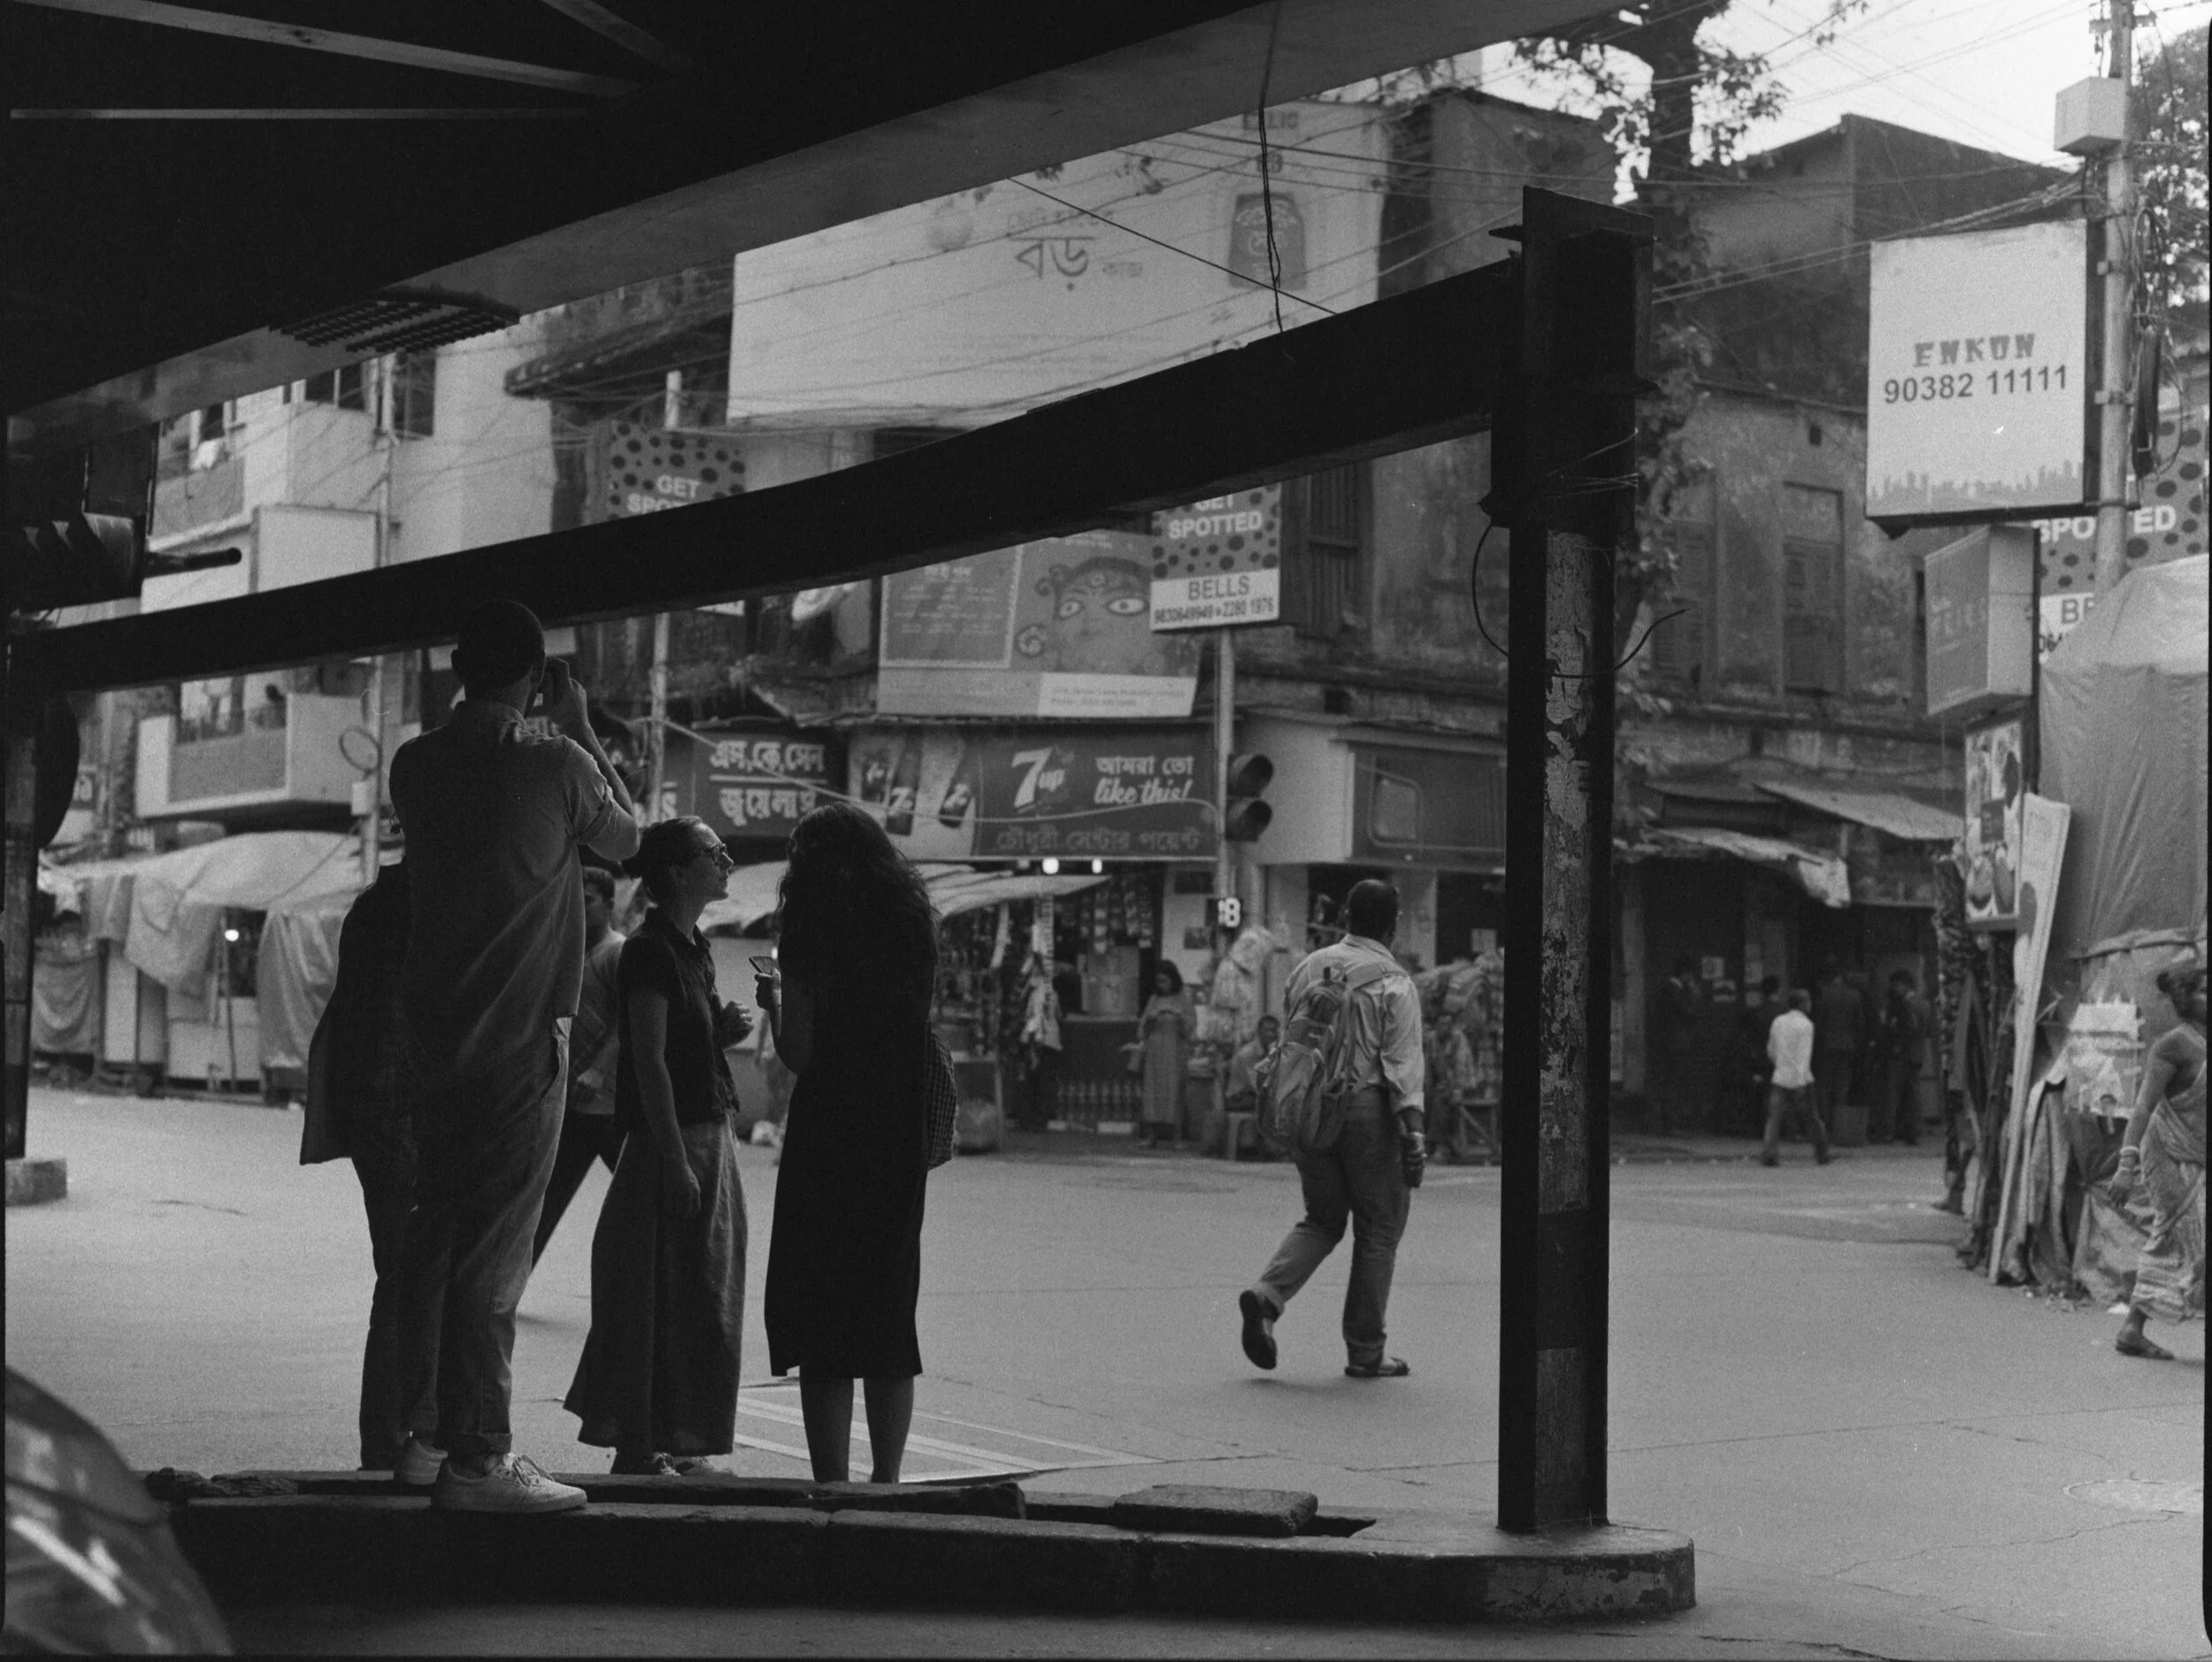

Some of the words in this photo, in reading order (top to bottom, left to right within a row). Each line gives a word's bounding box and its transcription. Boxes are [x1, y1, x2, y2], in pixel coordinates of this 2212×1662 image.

[1883, 372, 1974, 404] 90382
[1987, 364, 2068, 395] 11111
[656, 474, 701, 499] GET
[1167, 510, 1263, 539] SPOTTED
[2032, 504, 2177, 543] SPOED
[1187, 574, 1251, 600] BELLS
[1094, 777, 1139, 804] like
